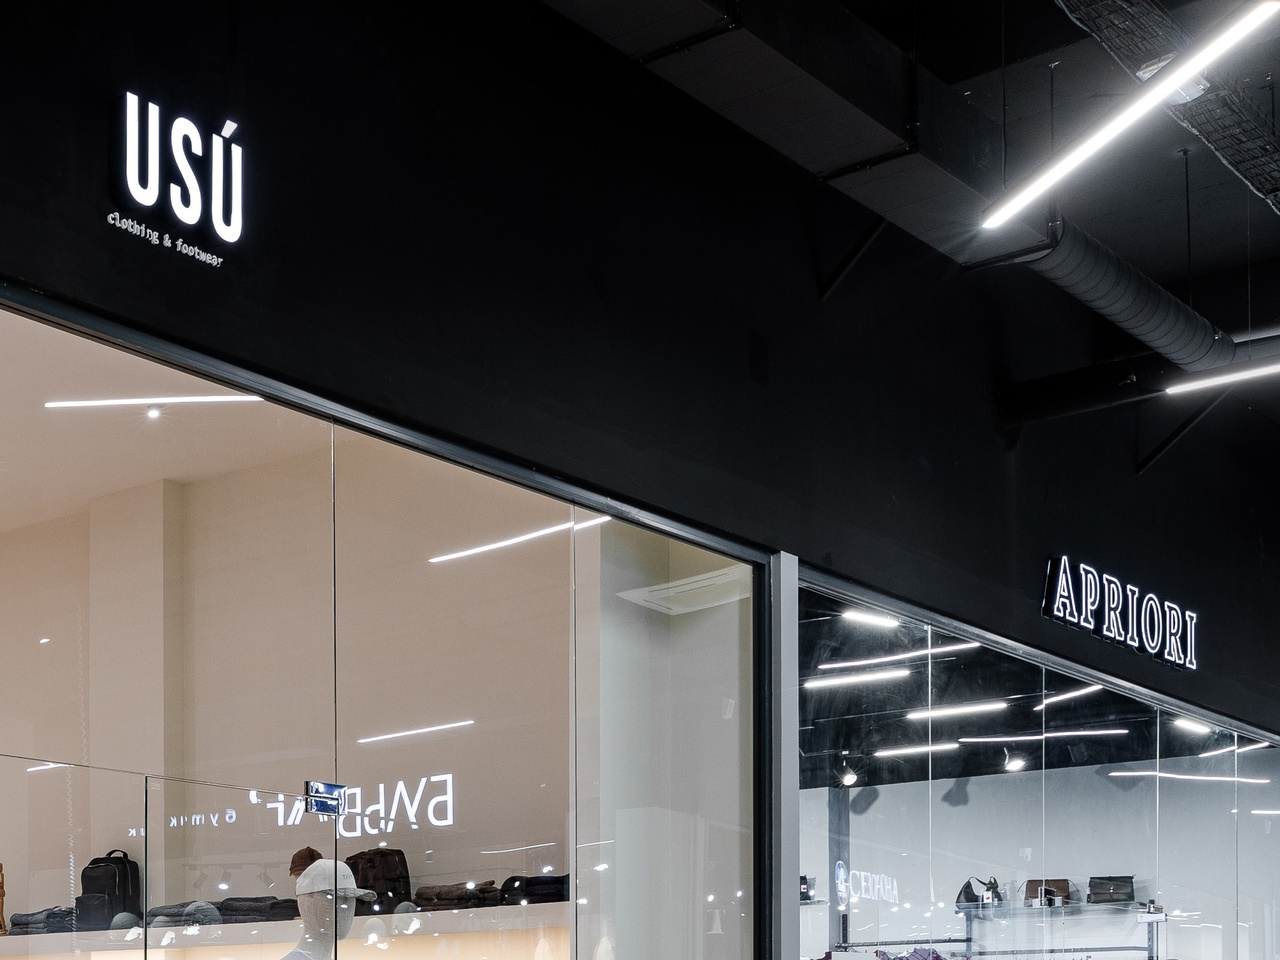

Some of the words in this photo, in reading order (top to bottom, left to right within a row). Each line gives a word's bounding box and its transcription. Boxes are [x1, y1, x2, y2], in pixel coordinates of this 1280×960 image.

[126, 91, 243, 243] USÚ
[107, 212, 160, 245] clothing
[163, 233, 172, 248] &
[175, 238, 224, 267] footwear
[1053, 555, 1197, 670] APRIORI
